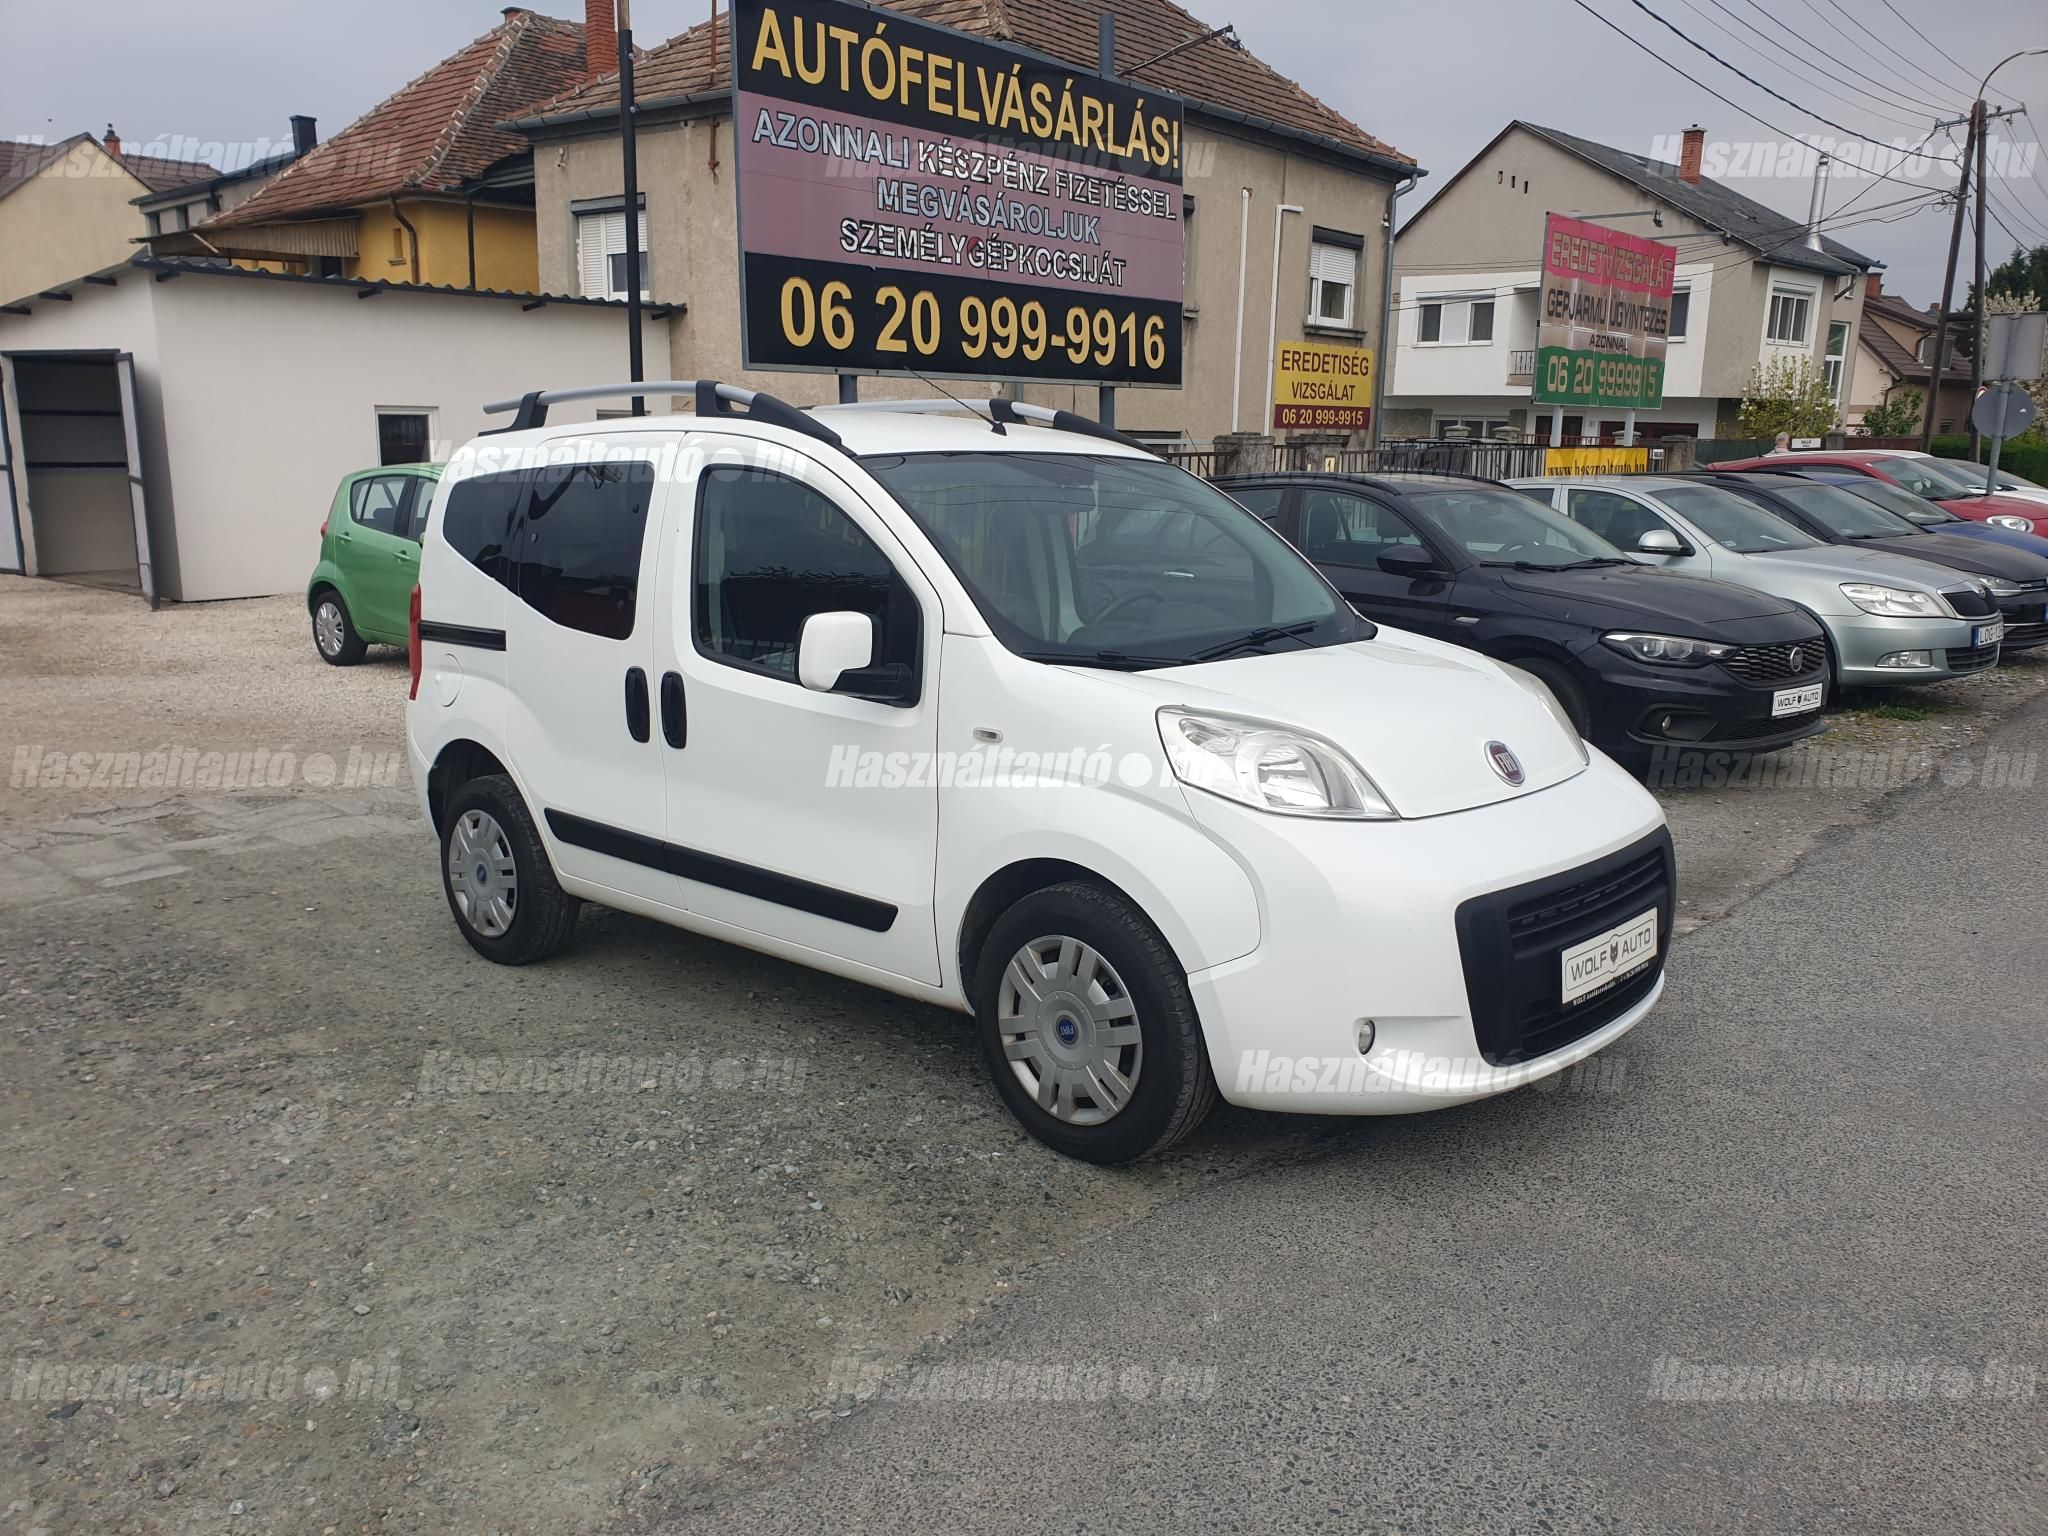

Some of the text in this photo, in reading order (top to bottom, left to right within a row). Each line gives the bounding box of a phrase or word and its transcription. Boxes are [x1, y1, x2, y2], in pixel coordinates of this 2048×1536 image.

[752, 8, 1179, 168] AUTÓFELVÁSÁRLÁS!
[752, 108, 1177, 221] AZONNALI KÉSZPÉNZ FIZETÉSSEL
[876, 177, 1101, 245] MEGVÁSÁROLJUK
[780, 276, 1165, 369] 06 20 999-9916
[1281, 349, 1369, 376] EREDETISÉG
[1547, 355, 1569, 393] 06
[1572, 357, 1594, 394] 20
[1291, 379, 1356, 401] VIZSGÁLAT
[1282, 408, 1364, 426] 06 20 999-9915
[1777, 691, 1819, 707] WOLF AUTO
[1571, 949, 1608, 982] WOLF
[1621, 927, 1651, 958] AUTO
